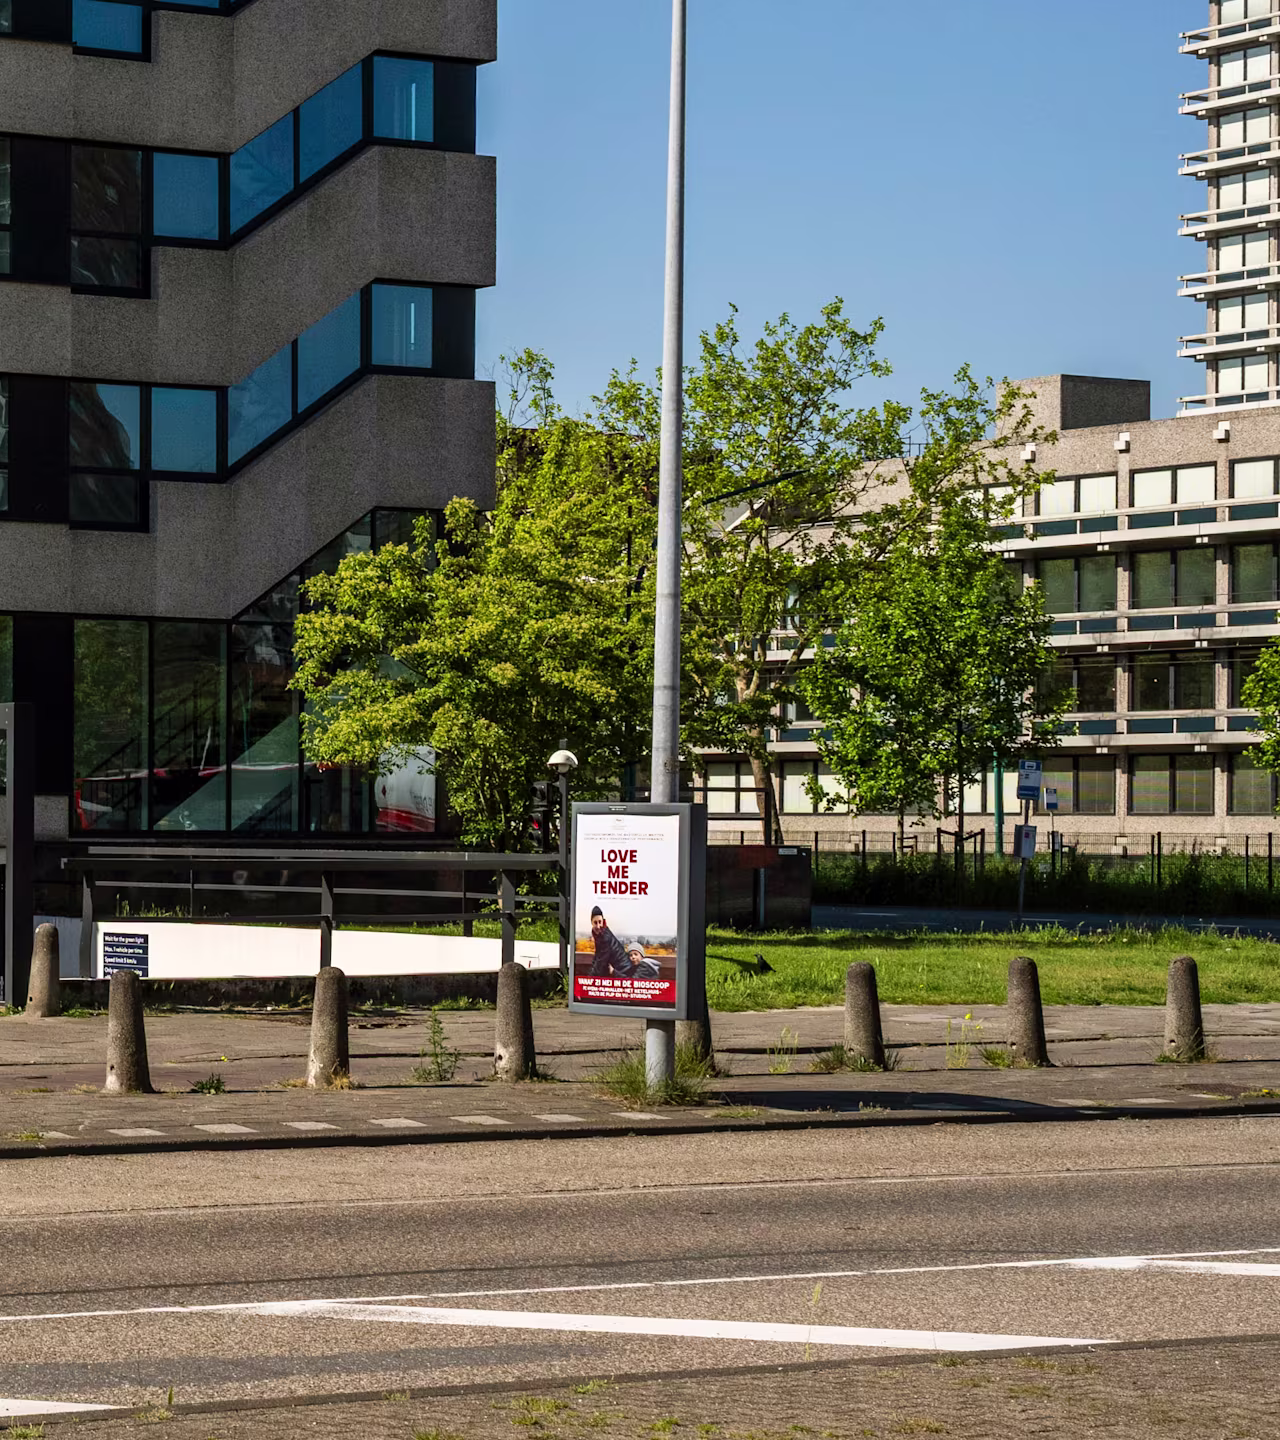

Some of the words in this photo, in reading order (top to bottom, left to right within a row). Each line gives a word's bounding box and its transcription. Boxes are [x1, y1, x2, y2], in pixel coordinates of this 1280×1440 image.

[601, 849, 638, 863] LOVE
[608, 865, 629, 879] ME
[593, 881, 648, 895] TENDER
[135, 937, 144, 945] light
[578, 977, 594, 985] VANAF
[602, 979, 613, 987] MEI
[622, 980, 632, 988] DE
[633, 981, 670, 990] BIOSCOOP
